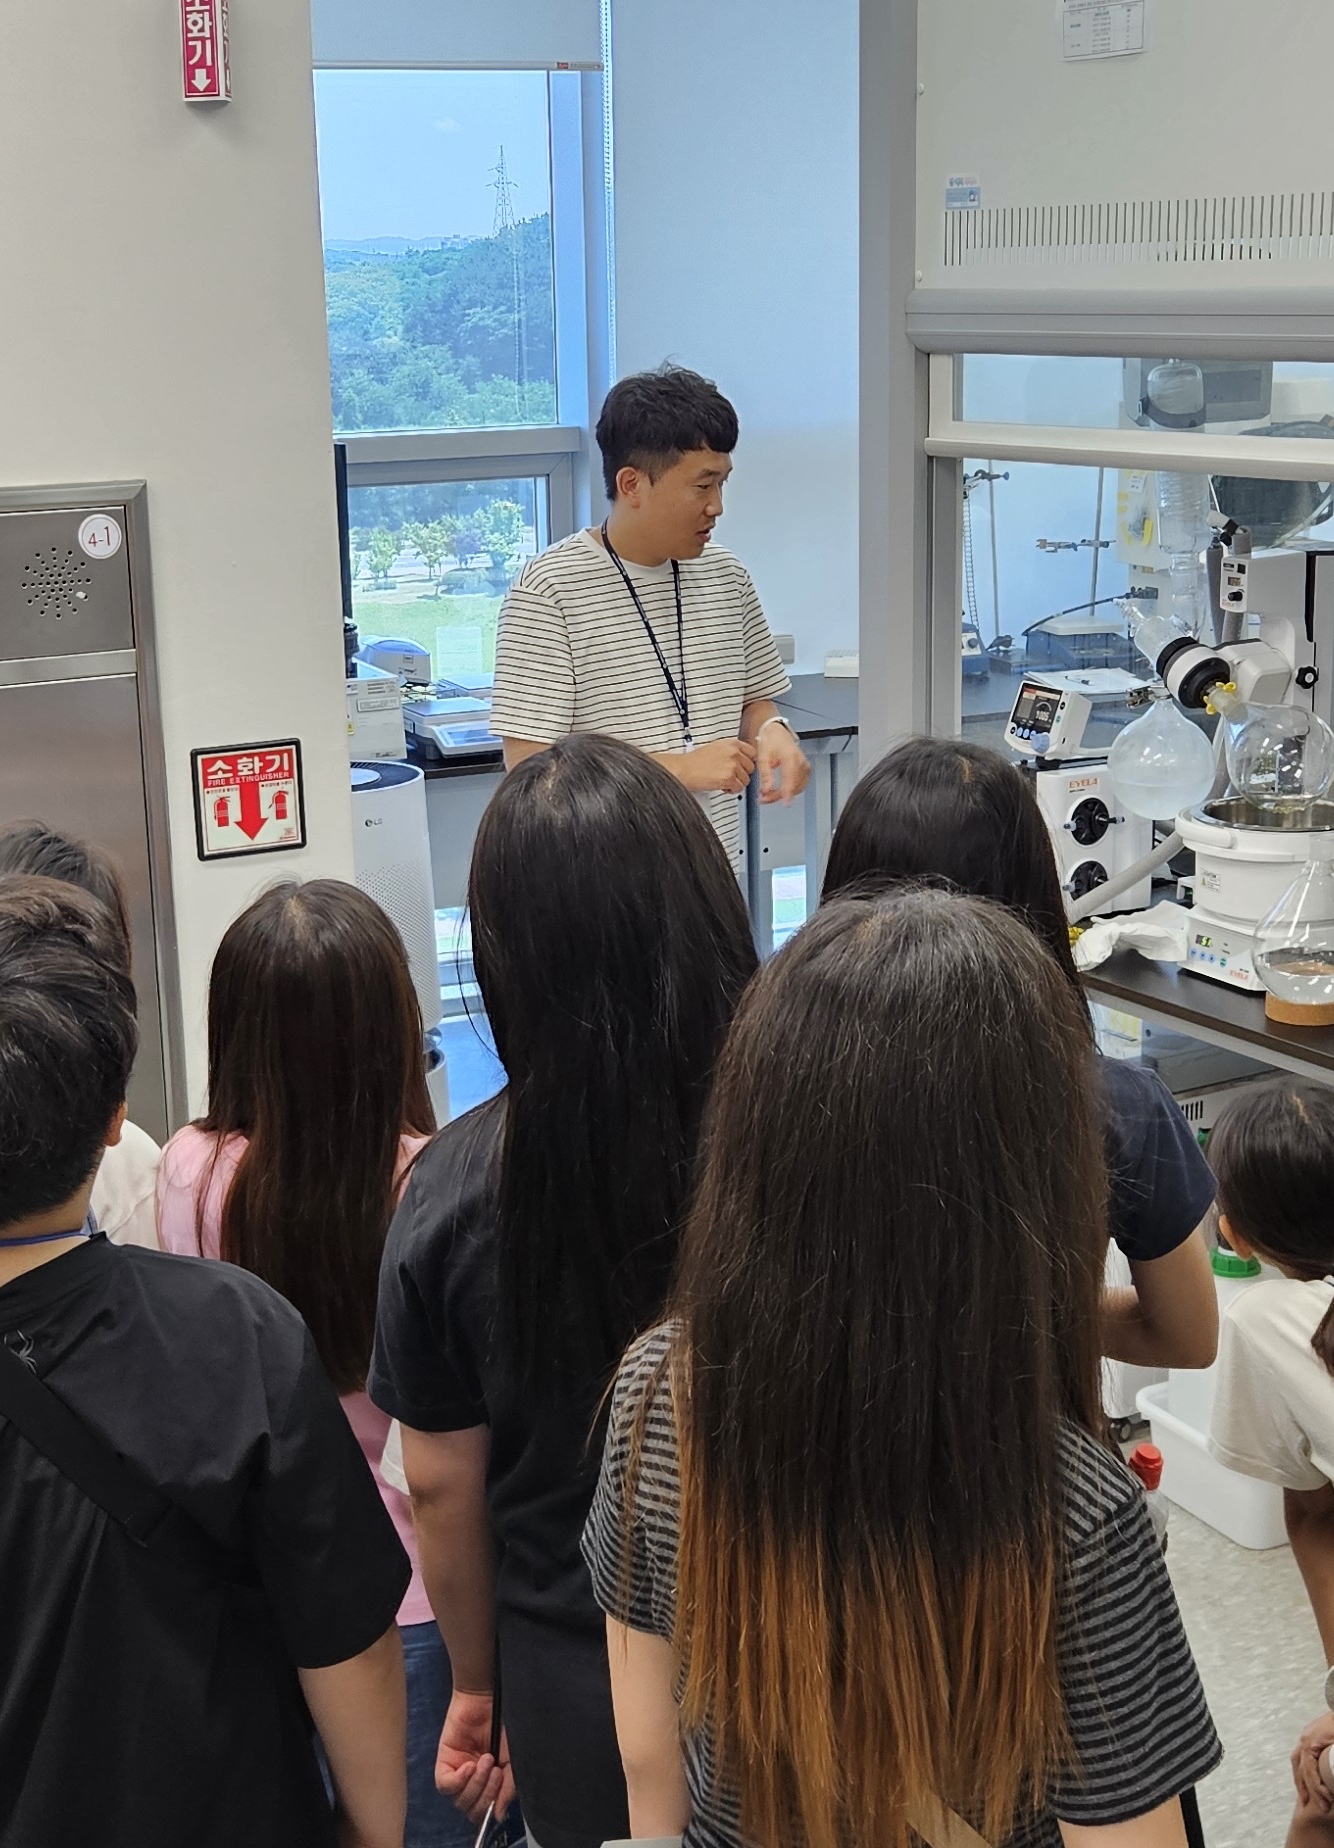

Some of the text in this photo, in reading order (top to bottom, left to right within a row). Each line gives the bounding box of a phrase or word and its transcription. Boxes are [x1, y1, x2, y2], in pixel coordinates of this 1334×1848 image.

[88, 526, 110, 547] 4-1
[207, 752, 289, 780] 소화기
[207, 779, 226, 787] FIRE
[230, 772, 289, 784] EXTINGUISHER
[1069, 778, 1097, 788] EYELA
